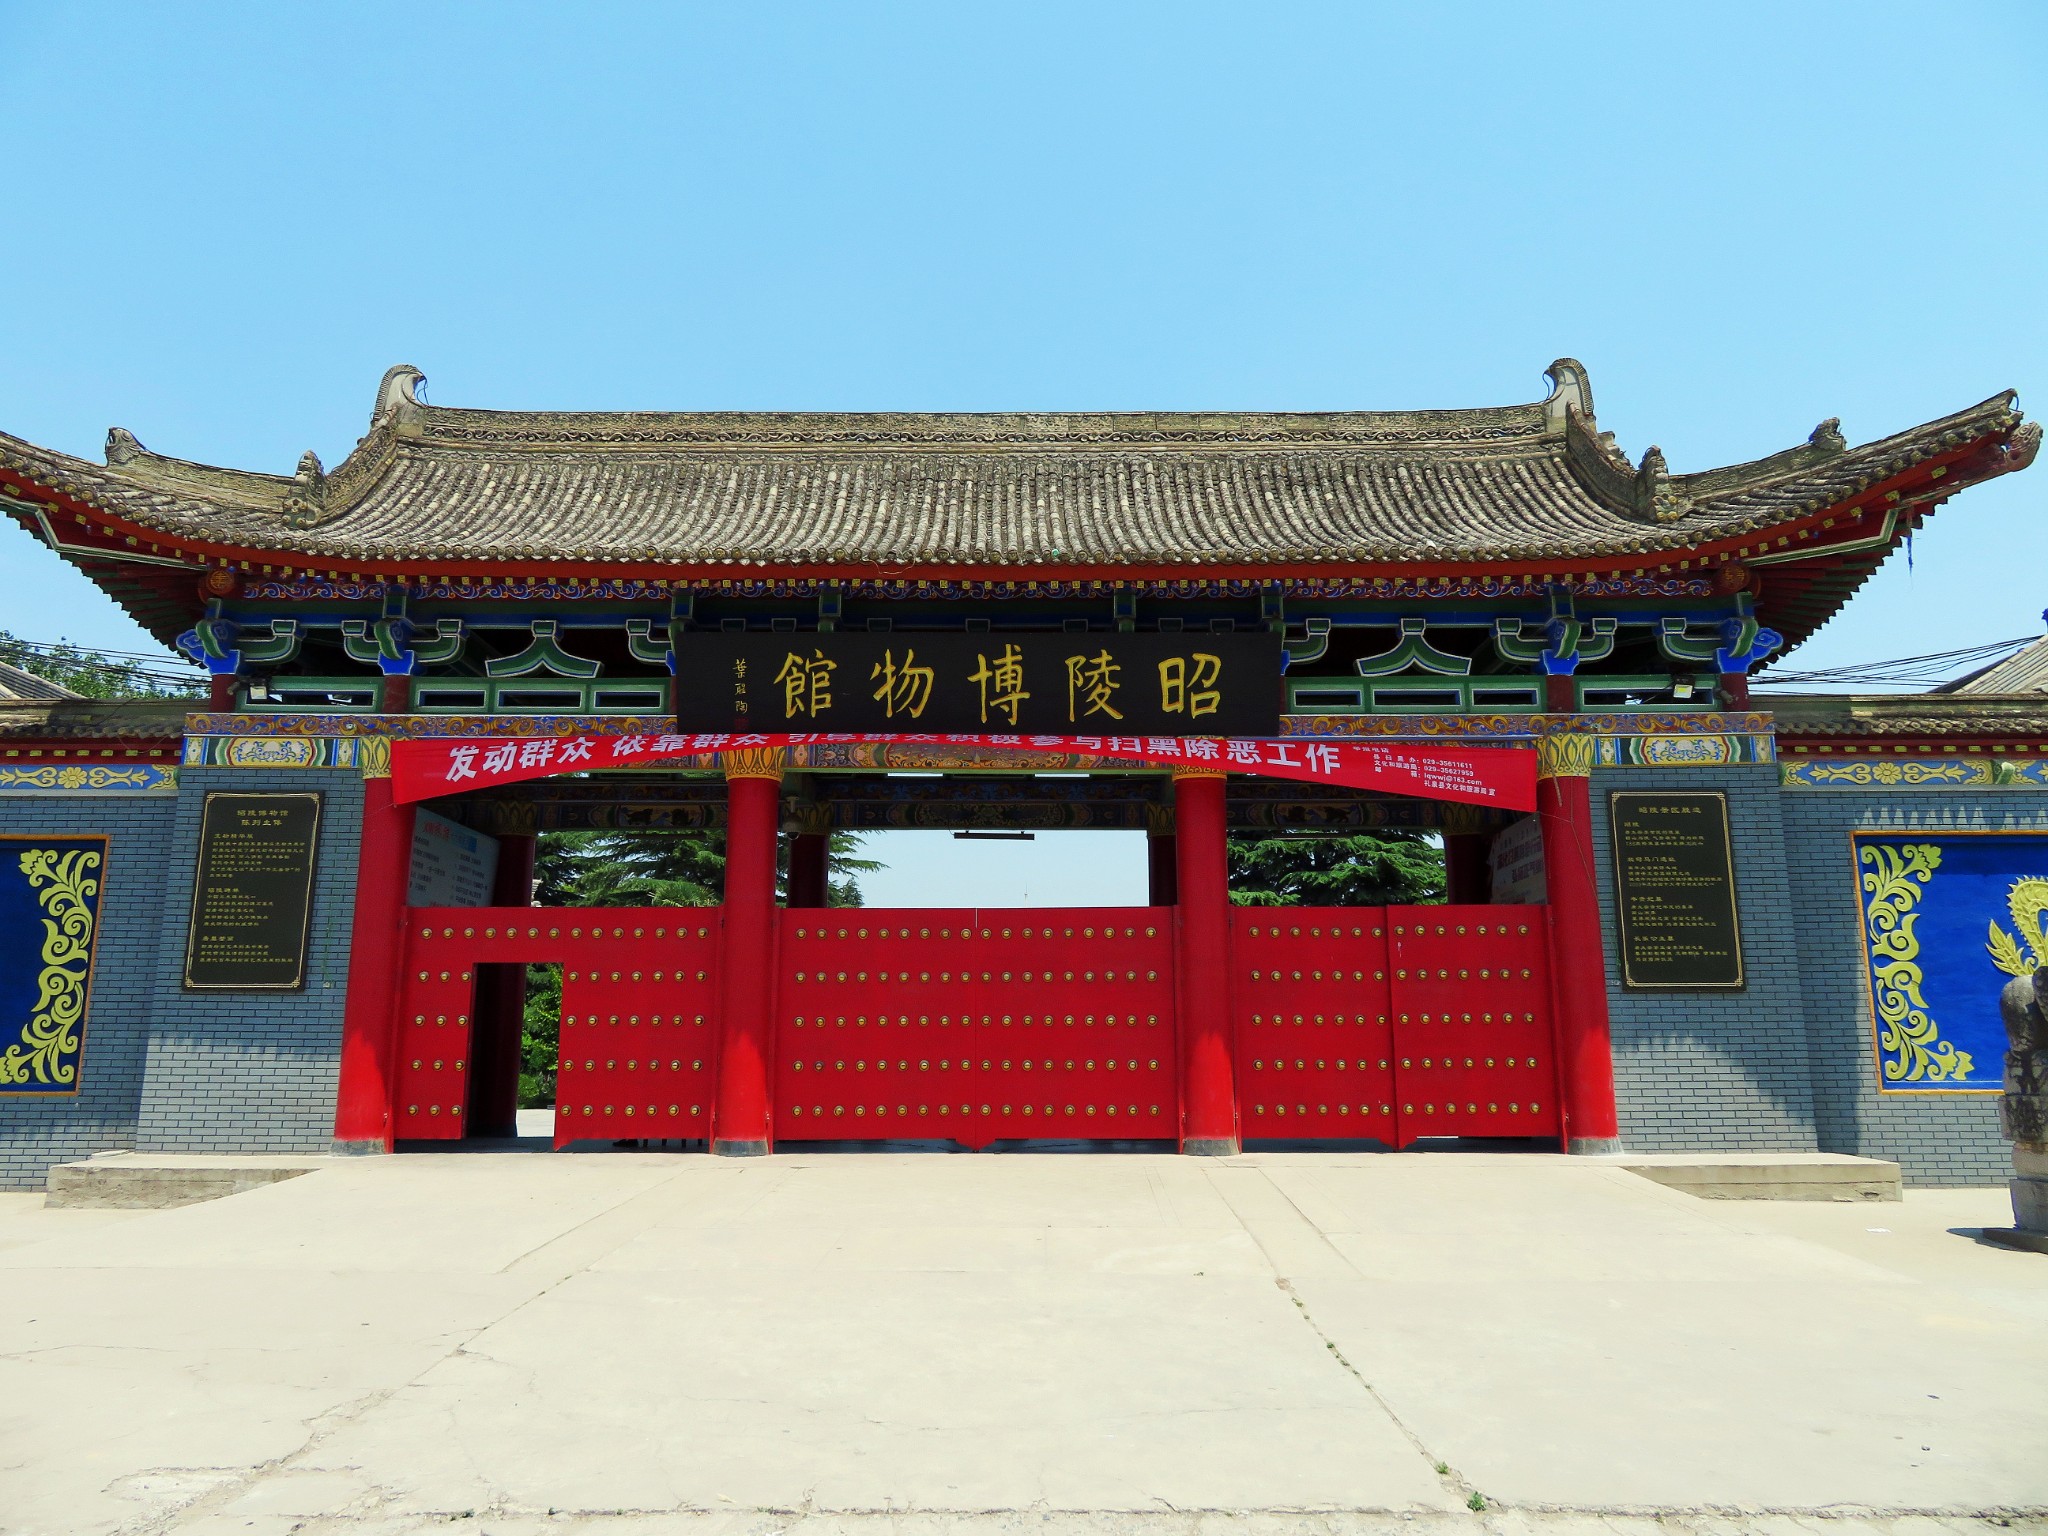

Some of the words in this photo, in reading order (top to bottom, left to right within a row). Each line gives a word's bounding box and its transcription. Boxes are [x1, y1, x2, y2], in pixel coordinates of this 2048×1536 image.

[445, 736, 597, 783] 发动群众
[612, 733, 770, 758] 依靠群众
